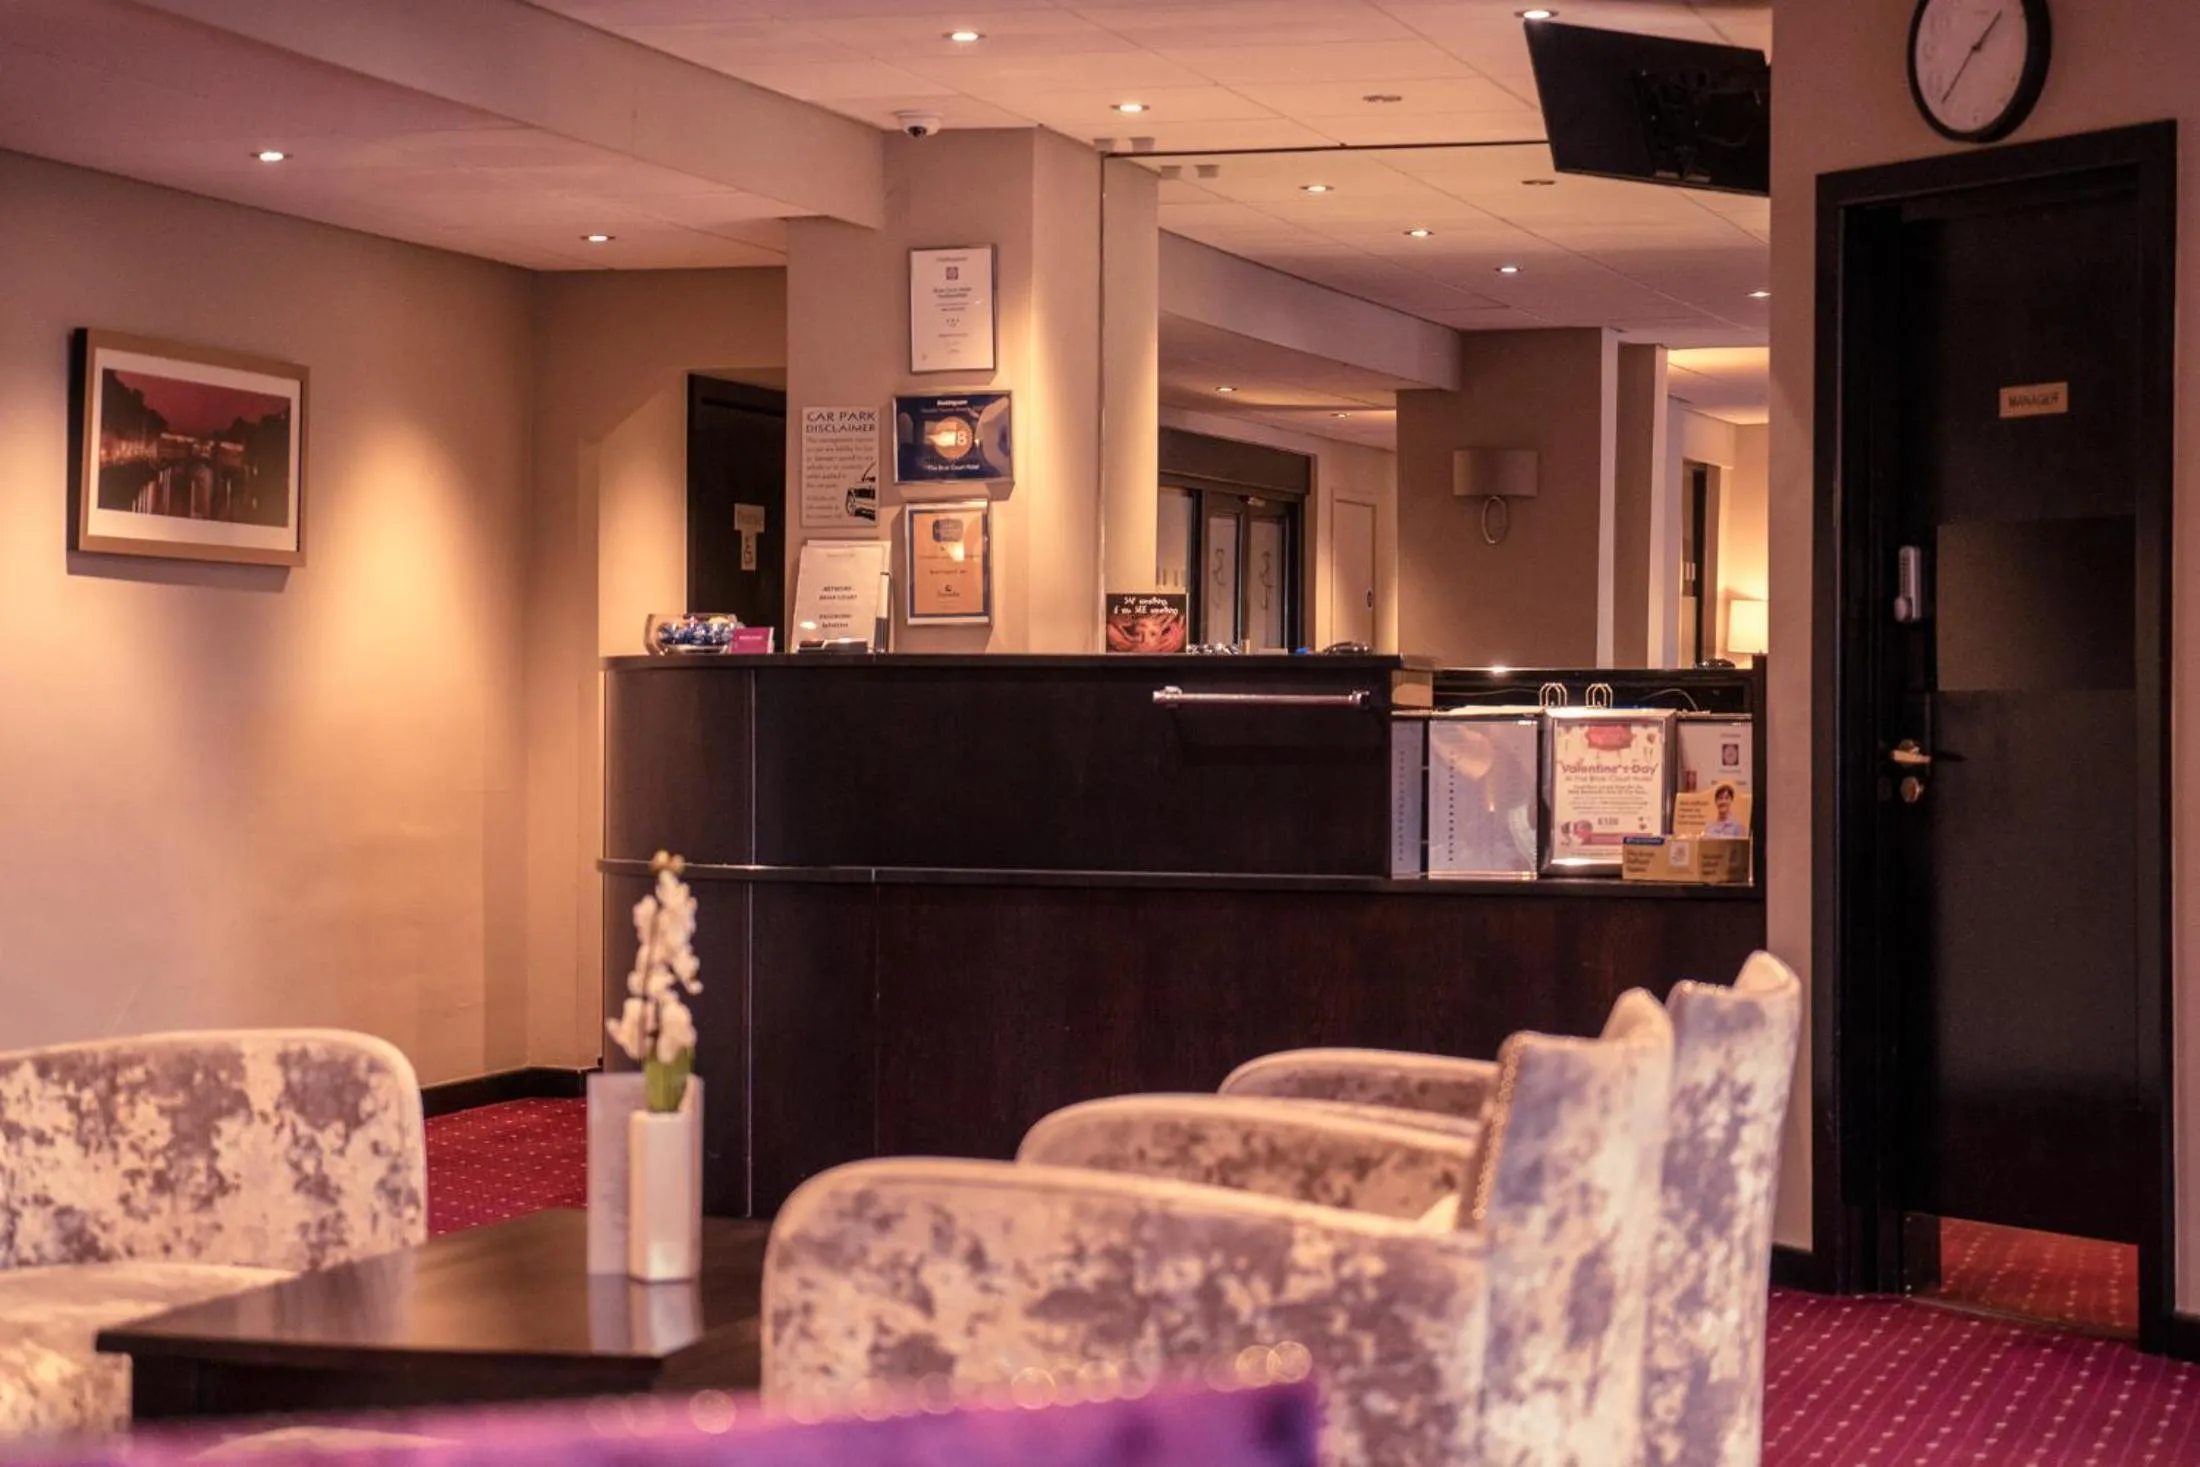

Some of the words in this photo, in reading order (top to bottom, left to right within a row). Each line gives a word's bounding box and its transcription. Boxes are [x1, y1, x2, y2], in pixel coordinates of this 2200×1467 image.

[806, 411, 834, 422] CAR
[839, 410, 876, 422] PARK
[805, 423, 875, 433] DISCLAIMER
[1562, 762, 1628, 774] Valentine's
[1632, 762, 1658, 775] Day
